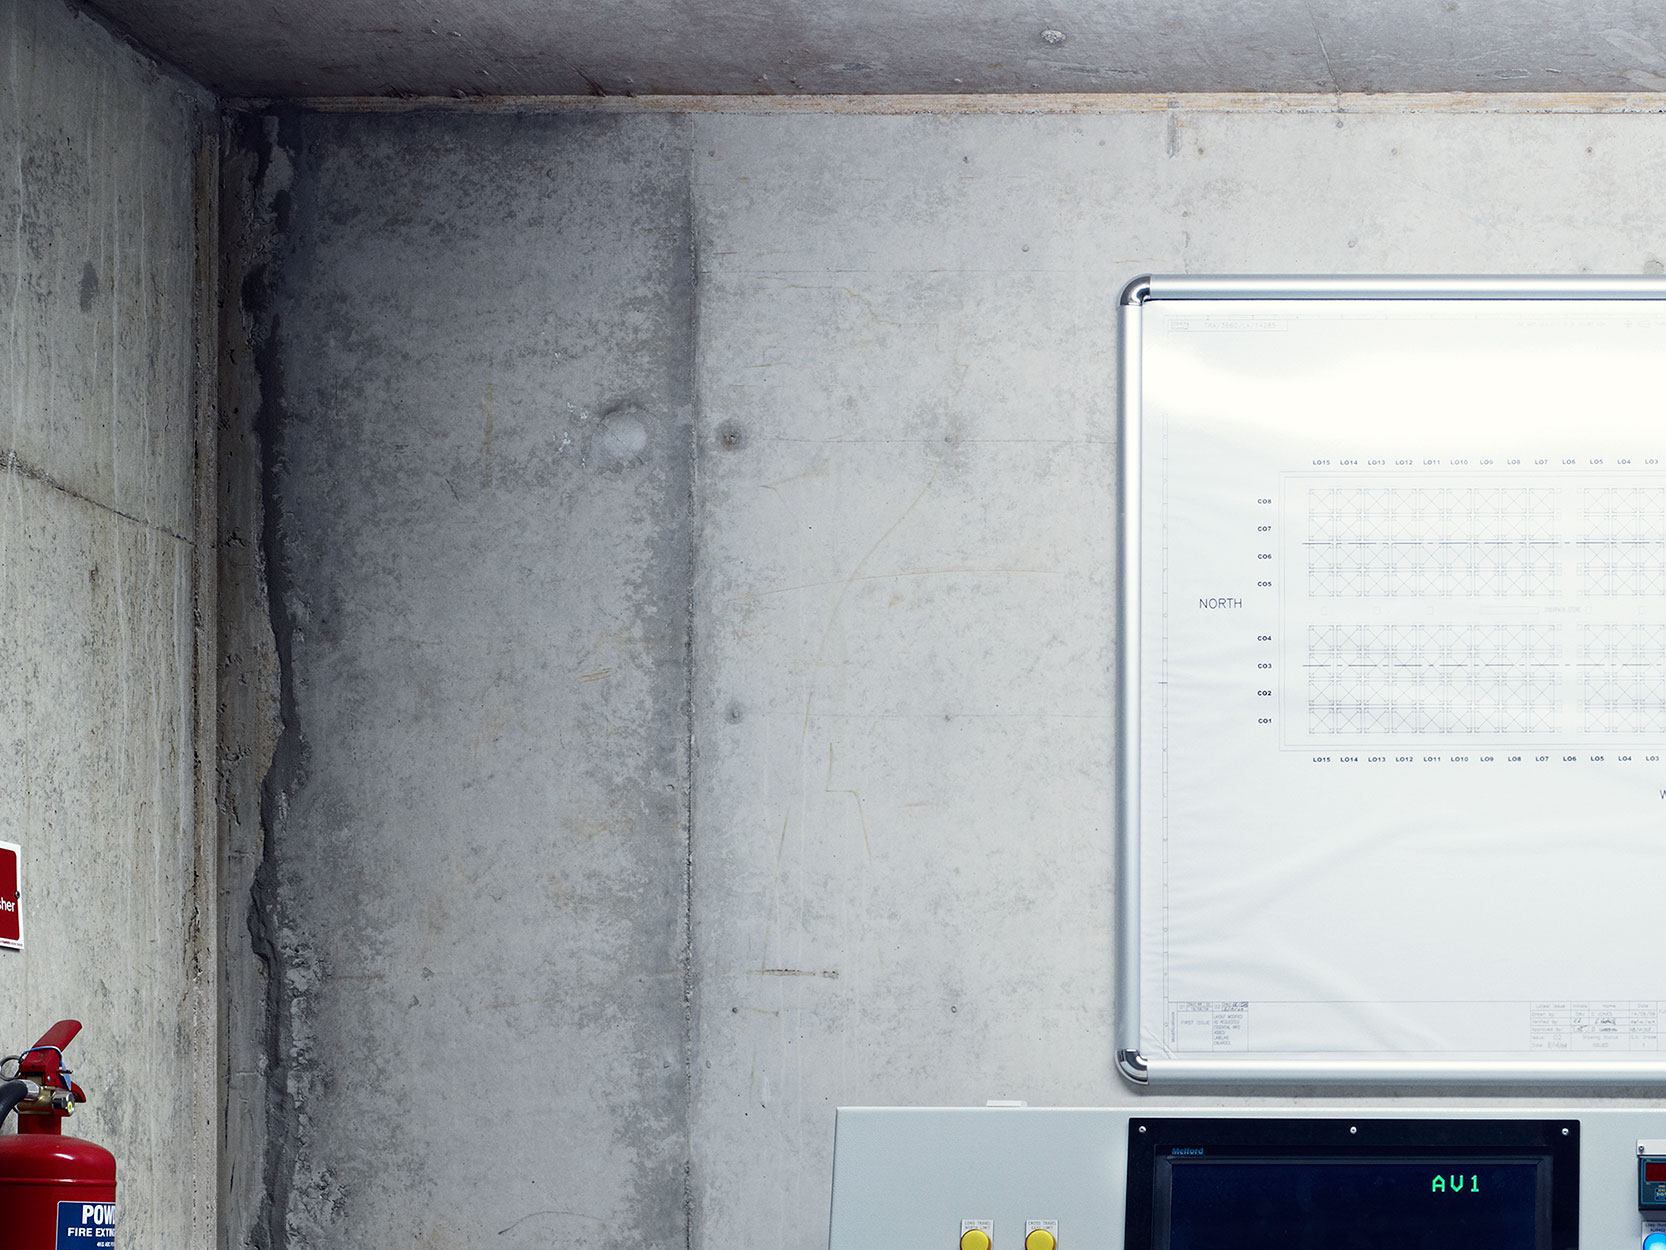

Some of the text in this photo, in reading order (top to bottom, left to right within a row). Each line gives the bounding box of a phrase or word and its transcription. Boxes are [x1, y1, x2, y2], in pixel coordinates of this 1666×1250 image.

[1199, 598, 1243, 610] NORTH
[1431, 1175, 1481, 1193] AV1
[68, 1228, 92, 1237] FIRE
